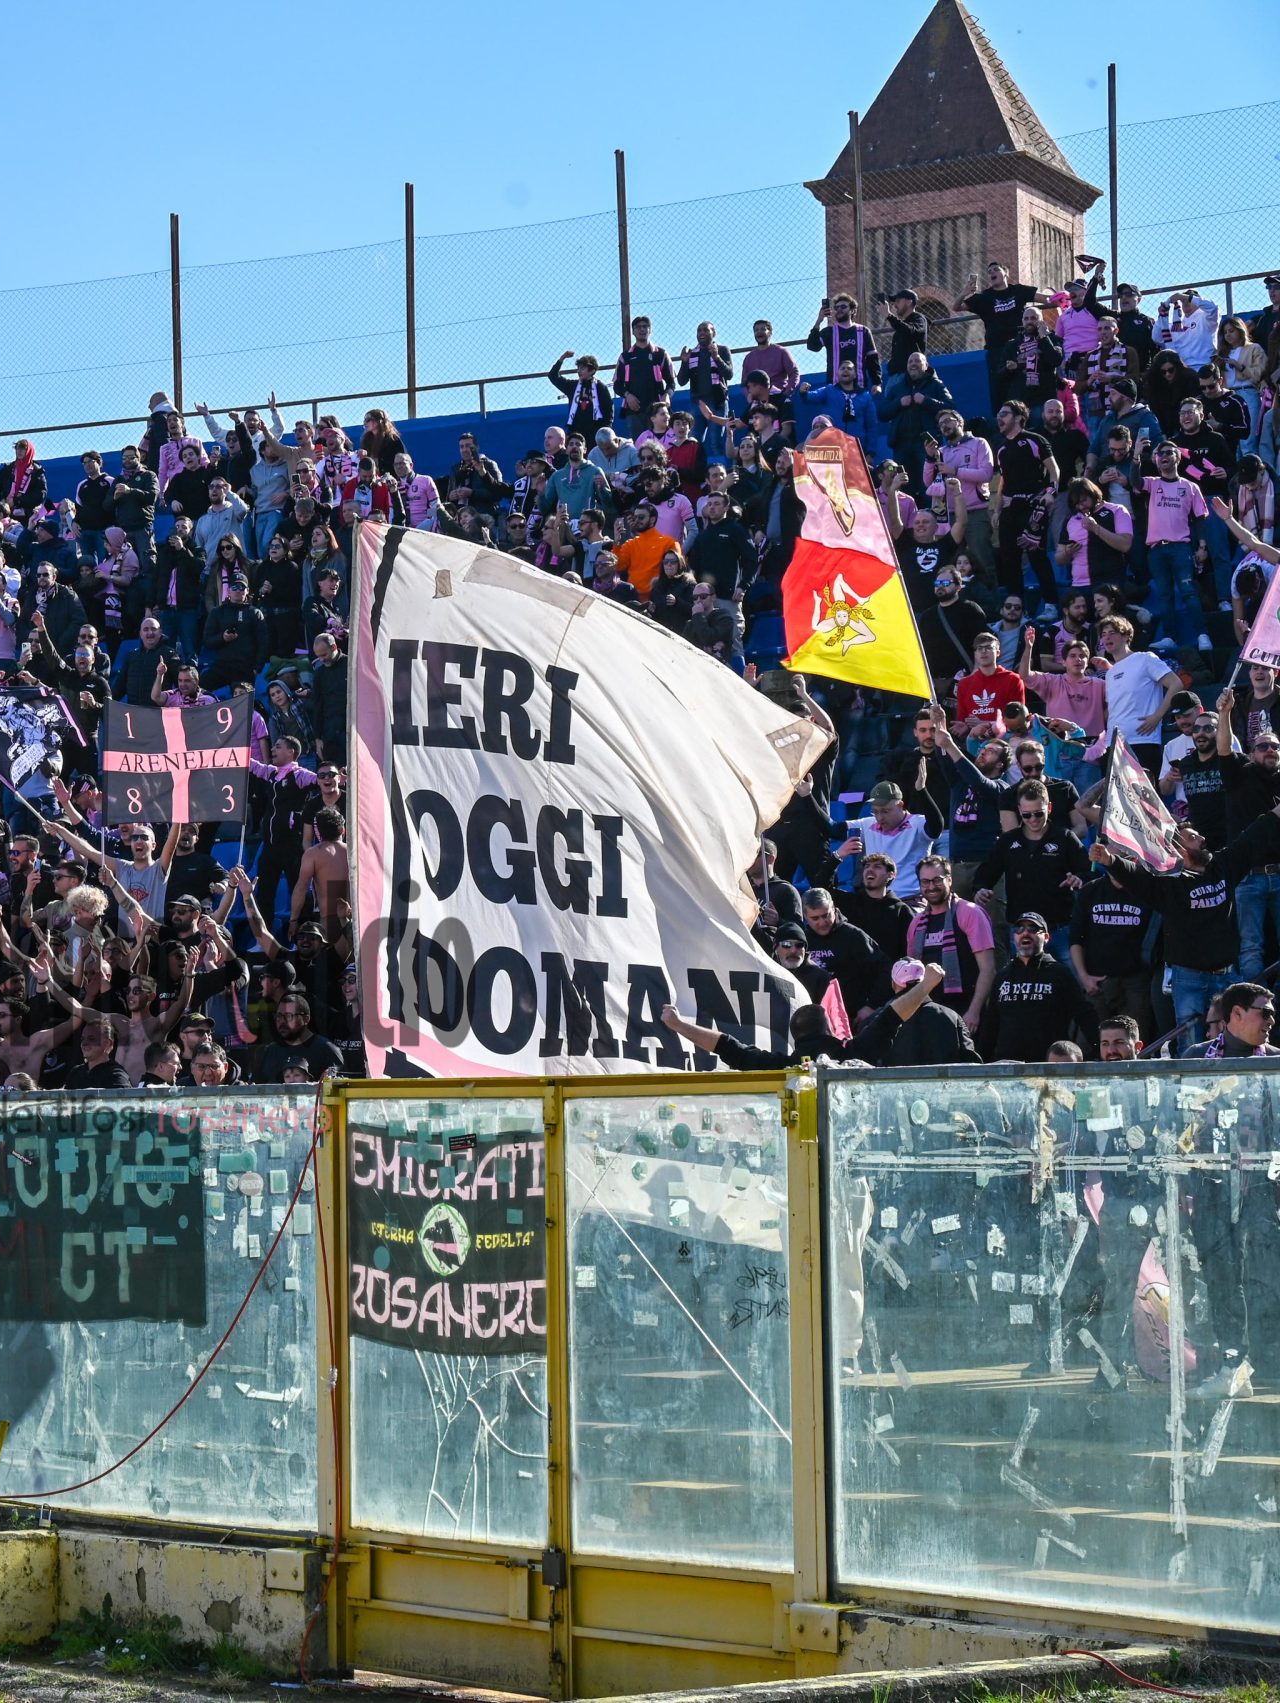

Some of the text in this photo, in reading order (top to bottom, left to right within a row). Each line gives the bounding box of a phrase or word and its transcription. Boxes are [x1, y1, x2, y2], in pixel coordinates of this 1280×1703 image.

[389, 638, 579, 767] IERI
[972, 707, 995, 715] adidas
[125, 707, 232, 739] 1 9
[118, 748, 240, 772] ARENELLA
[126, 784, 235, 815] 8 3
[405, 788, 629, 919] OGGI
[1092, 903, 1141, 915] CURVA SUD
[1092, 914, 1141, 925] PALERMO
[411, 928, 797, 1072] DOMANI
[352, 1132, 545, 1200] EMIGRATI
